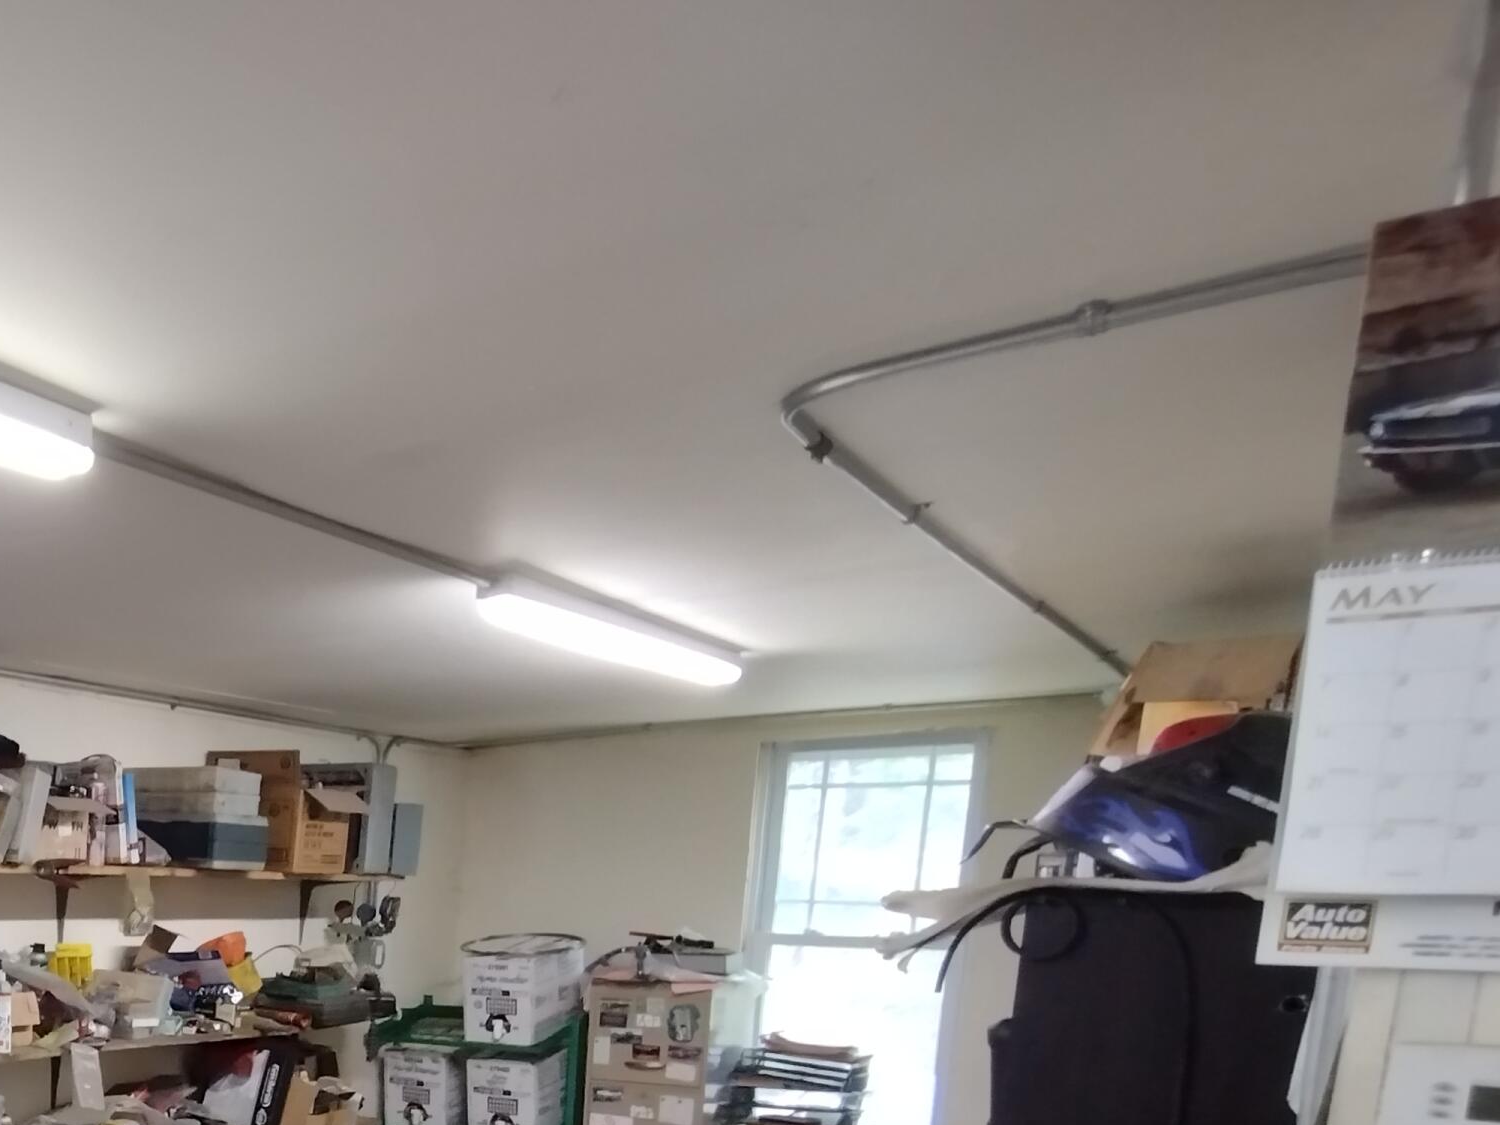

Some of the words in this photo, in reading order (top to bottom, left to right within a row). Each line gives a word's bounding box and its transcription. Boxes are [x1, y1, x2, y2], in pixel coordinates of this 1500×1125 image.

[1329, 582, 1437, 612] MAY
[1291, 903, 1368, 923] Auto
[1286, 921, 1368, 941] Value
